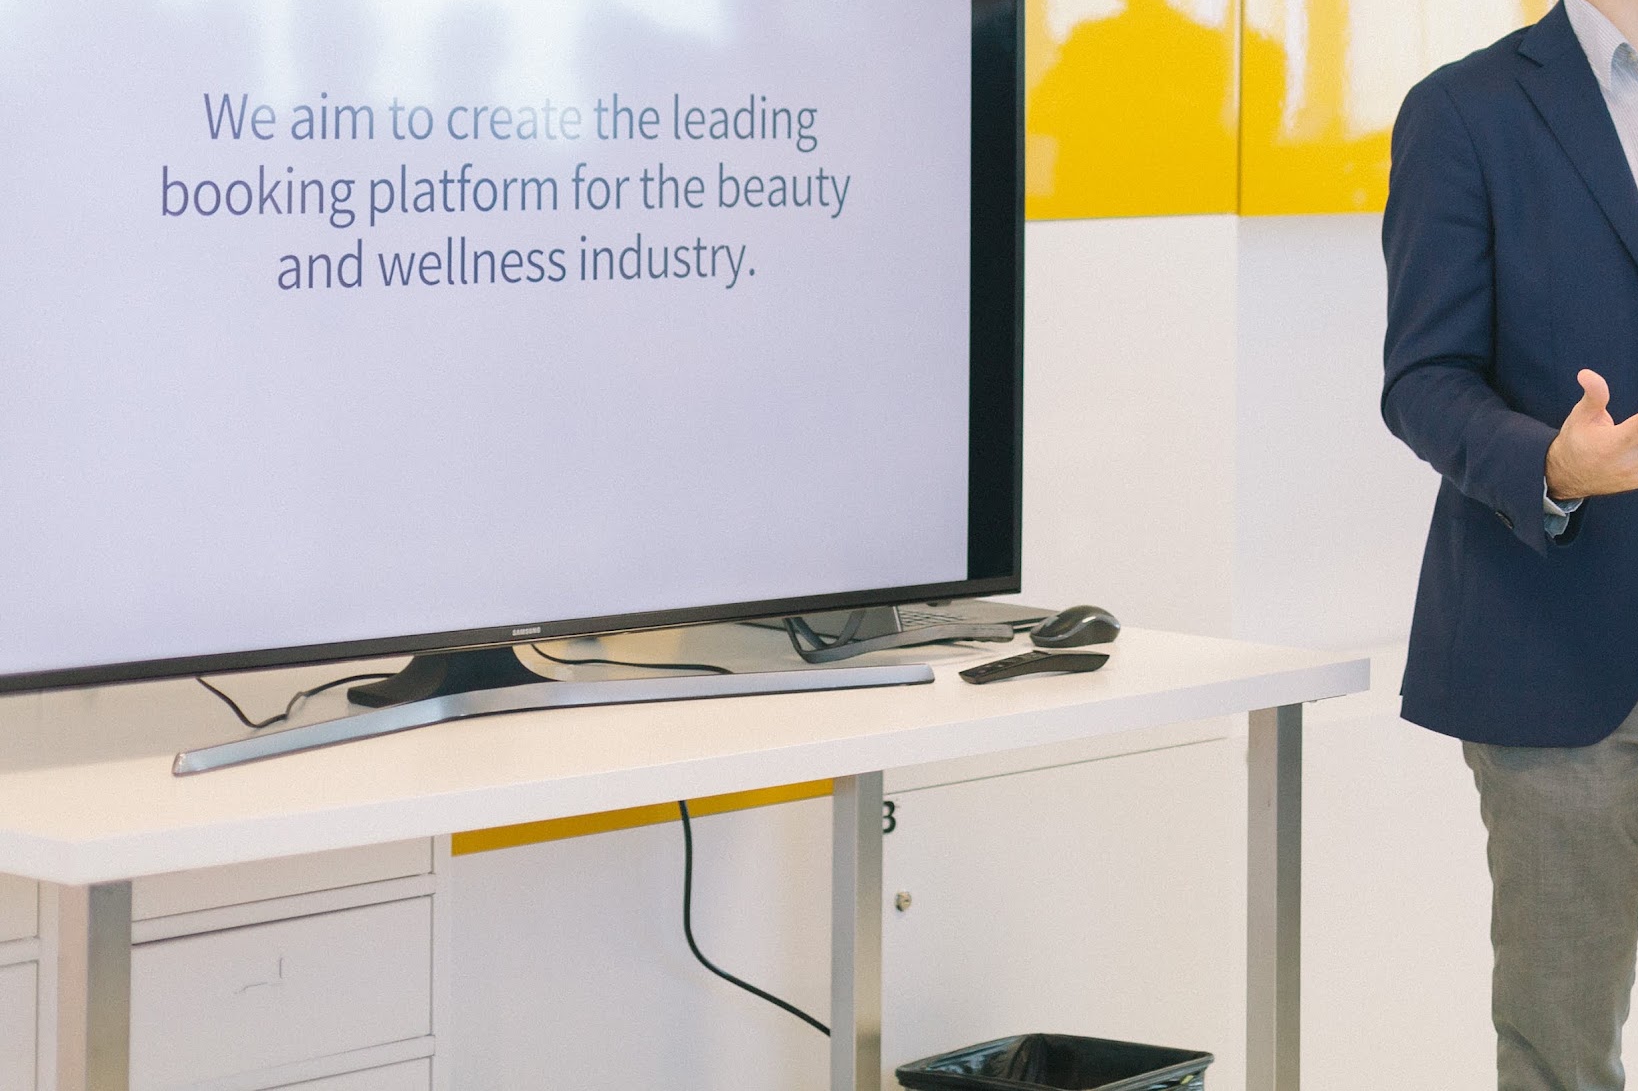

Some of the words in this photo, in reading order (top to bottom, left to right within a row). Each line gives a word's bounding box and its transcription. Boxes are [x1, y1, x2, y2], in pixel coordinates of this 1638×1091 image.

[203, 92, 277, 141] We
[290, 91, 375, 141] aim
[388, 99, 434, 141] to
[446, 99, 583, 141] create
[593, 92, 661, 141] the
[673, 92, 818, 154] leading
[161, 164, 356, 230] booking
[369, 162, 558, 228] platform
[570, 161, 631, 211] for
[638, 161, 706, 210] the
[718, 161, 852, 220] beauty
[277, 237, 363, 291] and
[377, 235, 567, 287] wellness
[580, 232, 756, 291] industry.
